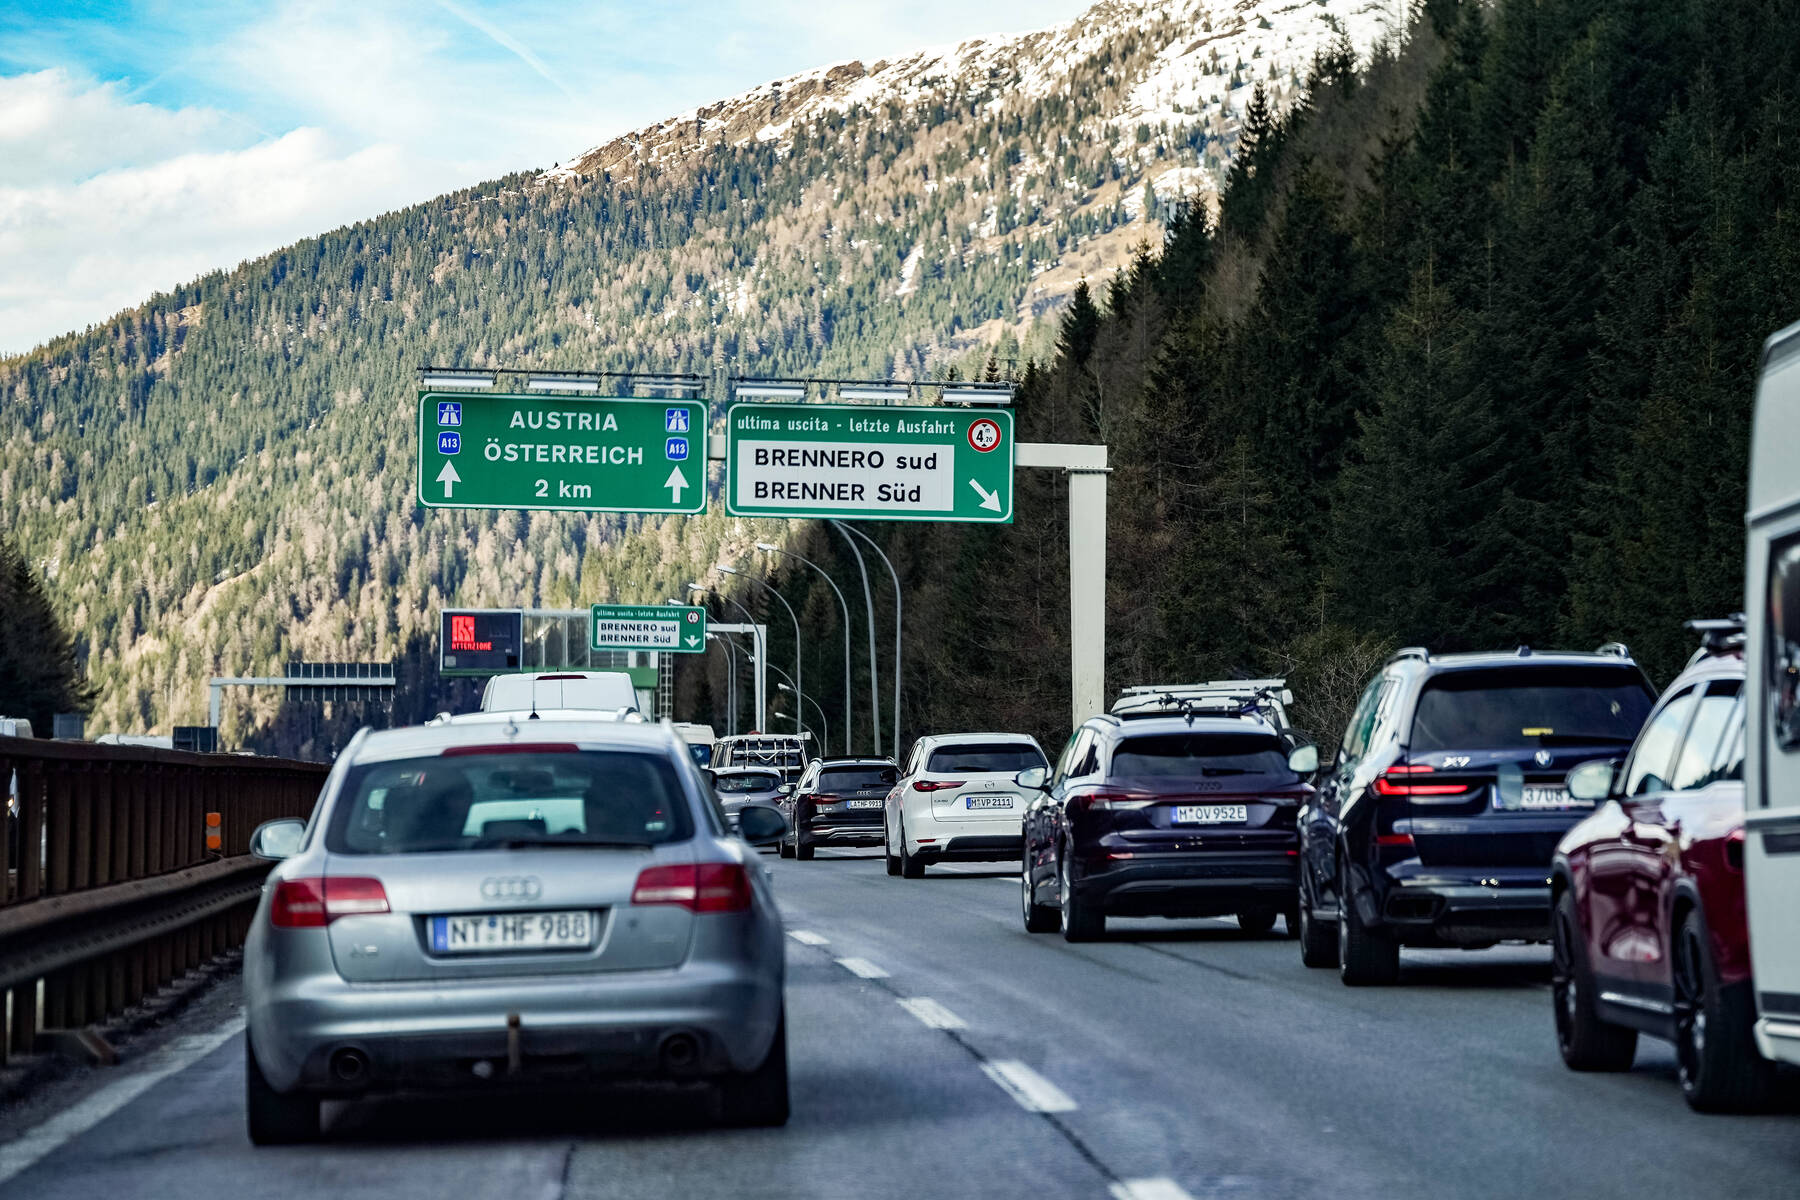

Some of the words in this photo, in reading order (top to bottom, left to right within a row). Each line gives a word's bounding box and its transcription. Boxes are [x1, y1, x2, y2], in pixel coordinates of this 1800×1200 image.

[509, 410, 619, 432] AUSTRIA
[737, 416, 780, 431] ultima
[787, 418, 829, 433] uscita
[849, 418, 890, 434] letzte
[896, 419, 956, 435] Ausfahrt
[441, 434, 458, 449] A13
[484, 437, 643, 465] ÖSTERREICH
[669, 439, 686, 455] A13
[754, 448, 885, 469] BRENNERO
[896, 453, 937, 470] sud
[535, 479, 549, 497] 2
[559, 480, 592, 498] km
[754, 481, 865, 501] BRENNER
[877, 483, 921, 503] Süd
[601, 623, 657, 632] BRENNERO
[601, 634, 648, 643] BRENNER
[653, 634, 671, 644] Süd
[971, 798, 977, 807] M
[981, 798, 991, 807] VP
[992, 798, 1011, 806] 2111
[1179, 808, 1188, 820] M
[452, 920, 483, 943] NT
[501, 916, 534, 942] HF
[540, 914, 586, 940] 988
